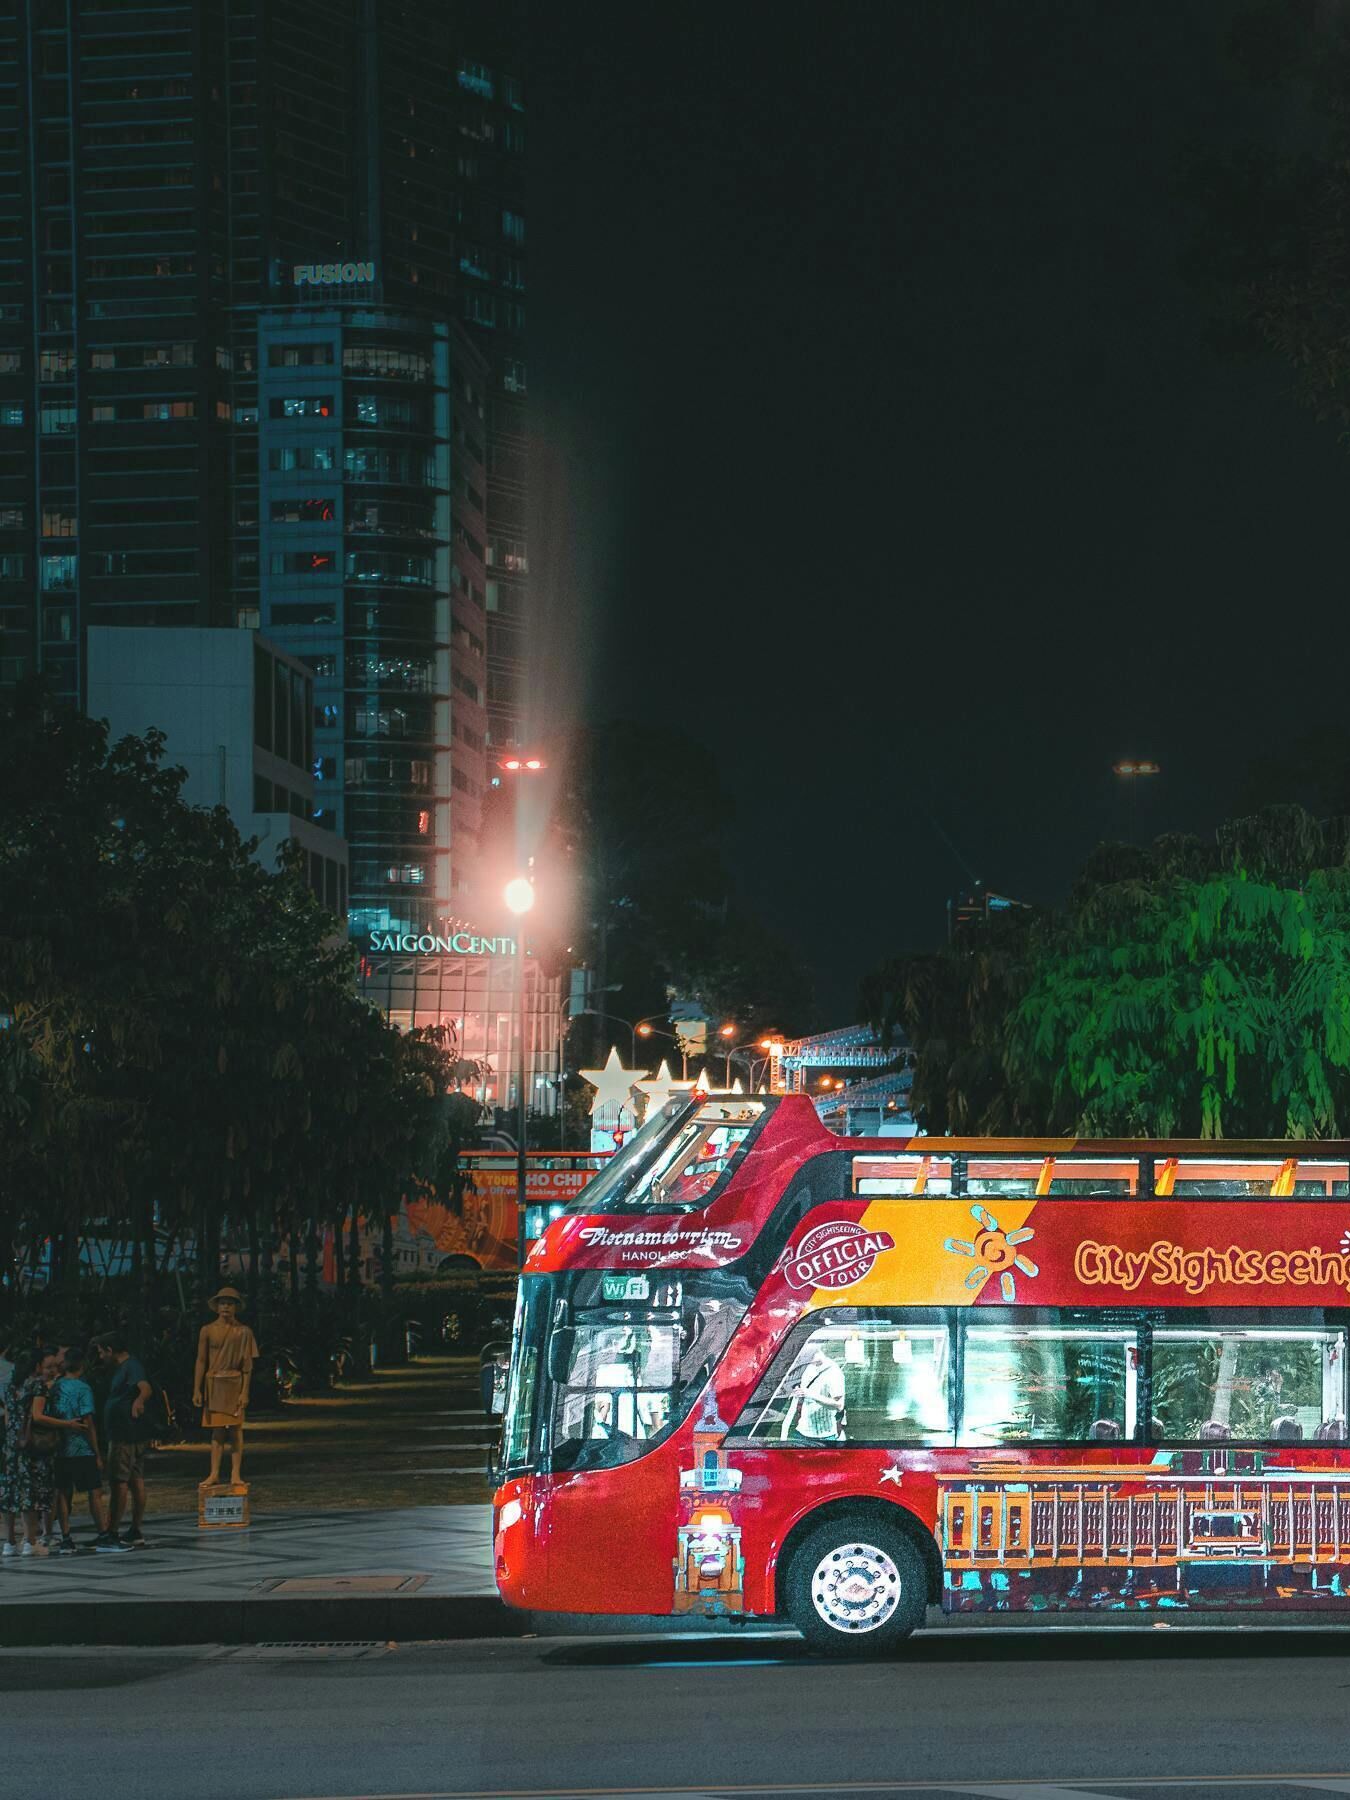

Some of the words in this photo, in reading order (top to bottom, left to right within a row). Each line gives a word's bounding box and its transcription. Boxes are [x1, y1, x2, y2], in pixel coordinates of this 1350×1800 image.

[293, 262, 375, 286] FUSION
[487, 1175, 517, 1186] TOUR
[525, 1173, 550, 1187] HO
[553, 1173, 583, 1187] CHI
[804, 1236, 818, 1252] CITY
[815, 1225, 862, 1241] SIGHTSEEING
[622, 1251, 661, 1261] HANOI
[796, 1234, 890, 1281] OFFICIAL
[828, 1260, 871, 1285] TOUR
